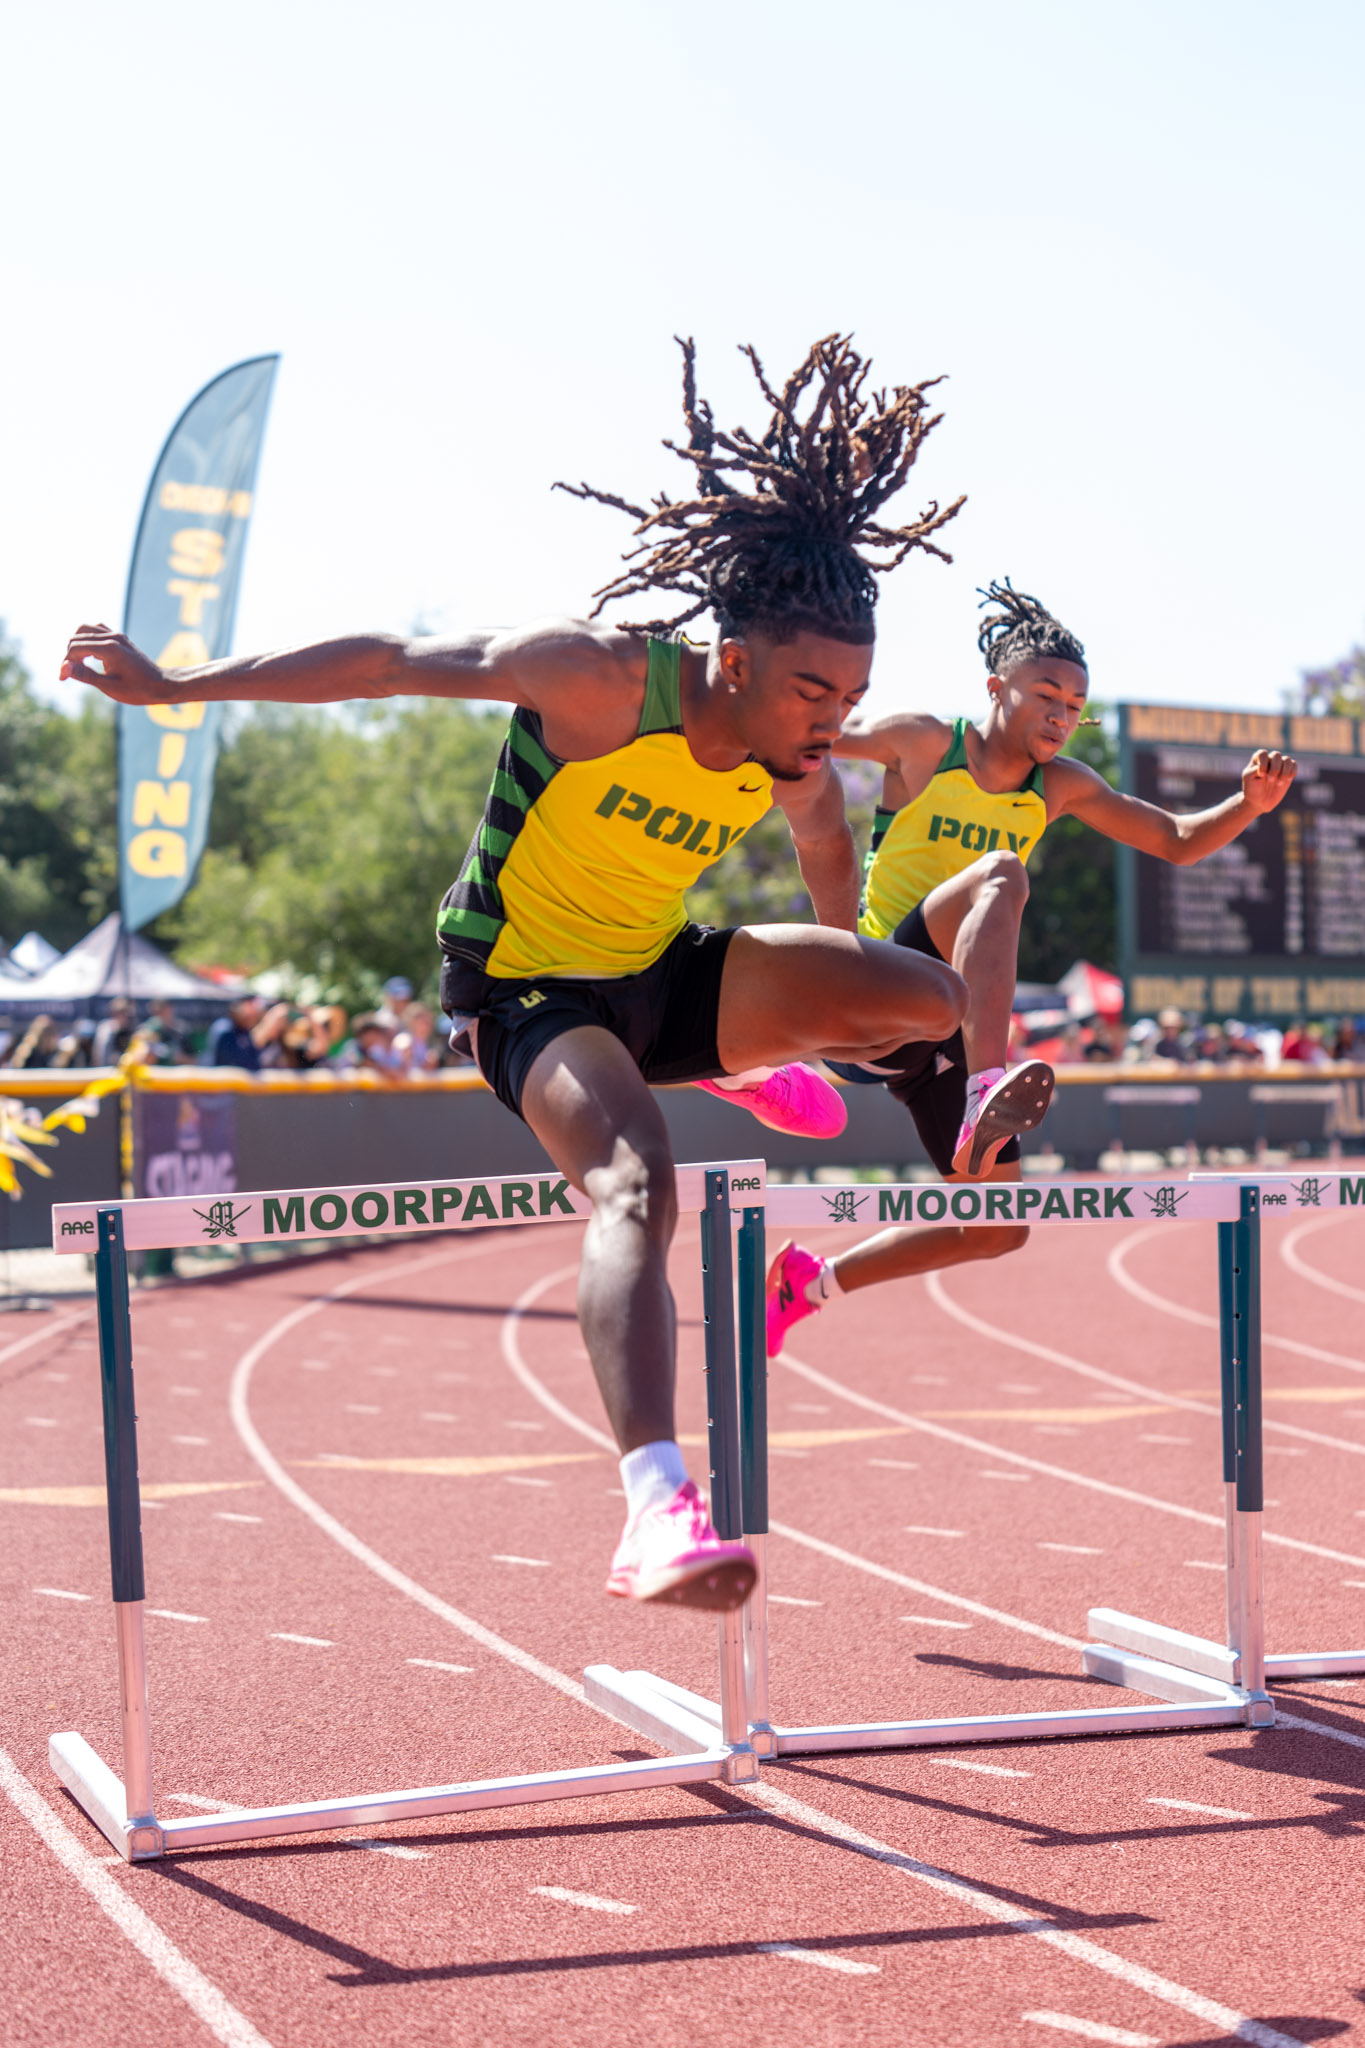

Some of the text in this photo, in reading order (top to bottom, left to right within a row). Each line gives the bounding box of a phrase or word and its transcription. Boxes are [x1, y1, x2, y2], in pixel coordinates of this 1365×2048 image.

[594, 783, 747, 857] POLY
[927, 813, 1031, 854] POLY
[262, 1179, 576, 1234] MOORPARK
[878, 1186, 1135, 1222] MOORPARK
